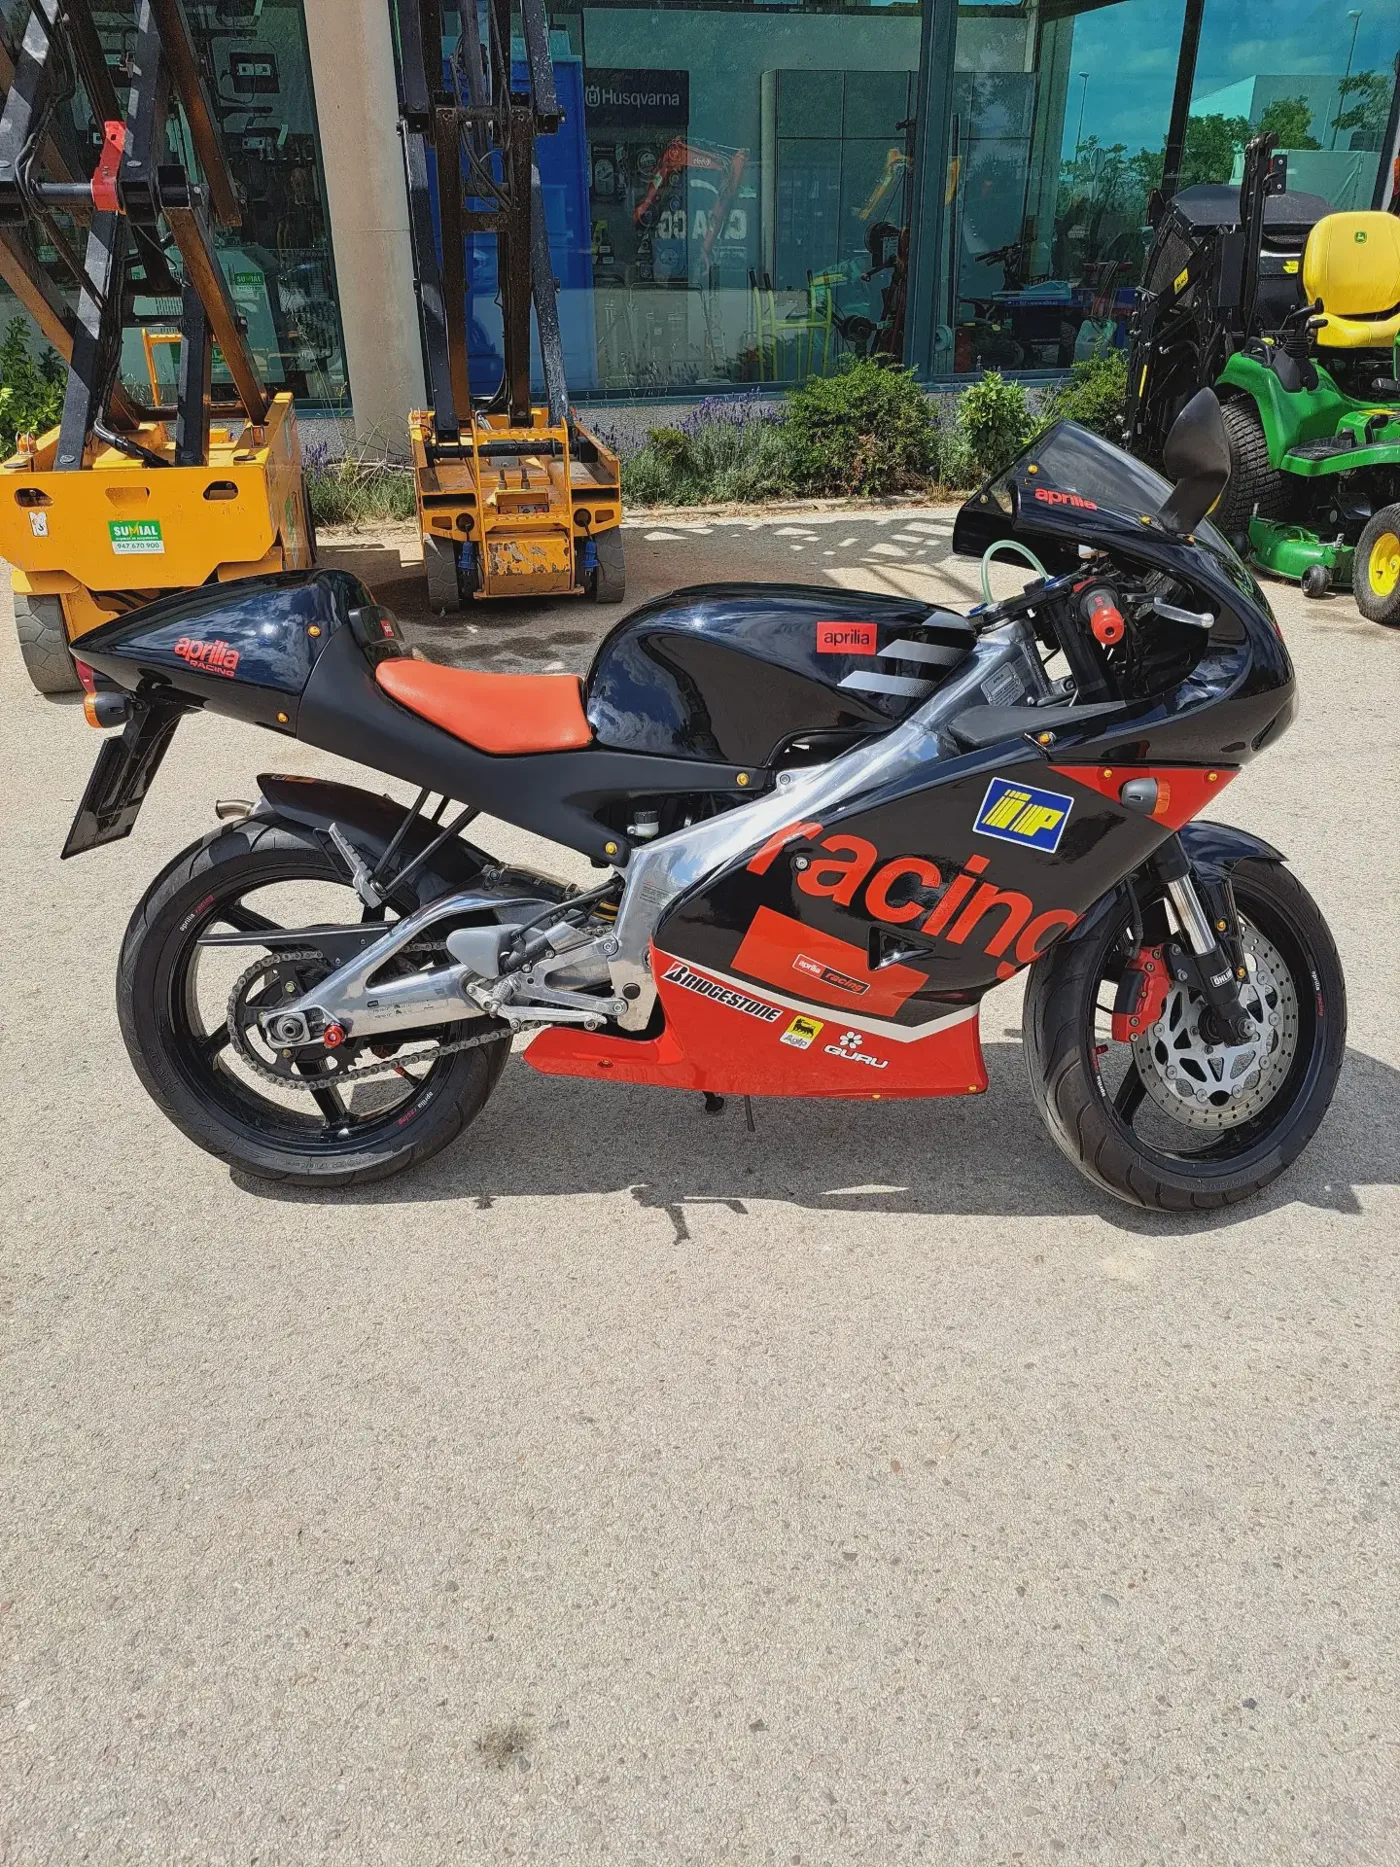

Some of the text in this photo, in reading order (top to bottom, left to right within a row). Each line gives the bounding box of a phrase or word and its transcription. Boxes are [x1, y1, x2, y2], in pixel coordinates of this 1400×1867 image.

[602, 88, 680, 108] Husqvarna
[113, 521, 158, 537] SUMIAL
[823, 629, 870, 646] aprilia
[174, 637, 240, 671] aprilia
[190, 660, 235, 677] RACING
[798, 960, 864, 992] aprilia racing
[663, 966, 781, 1021] BRIDGESTONE
[784, 1034, 808, 1048] Agip
[824, 1045, 889, 1069] GURU
